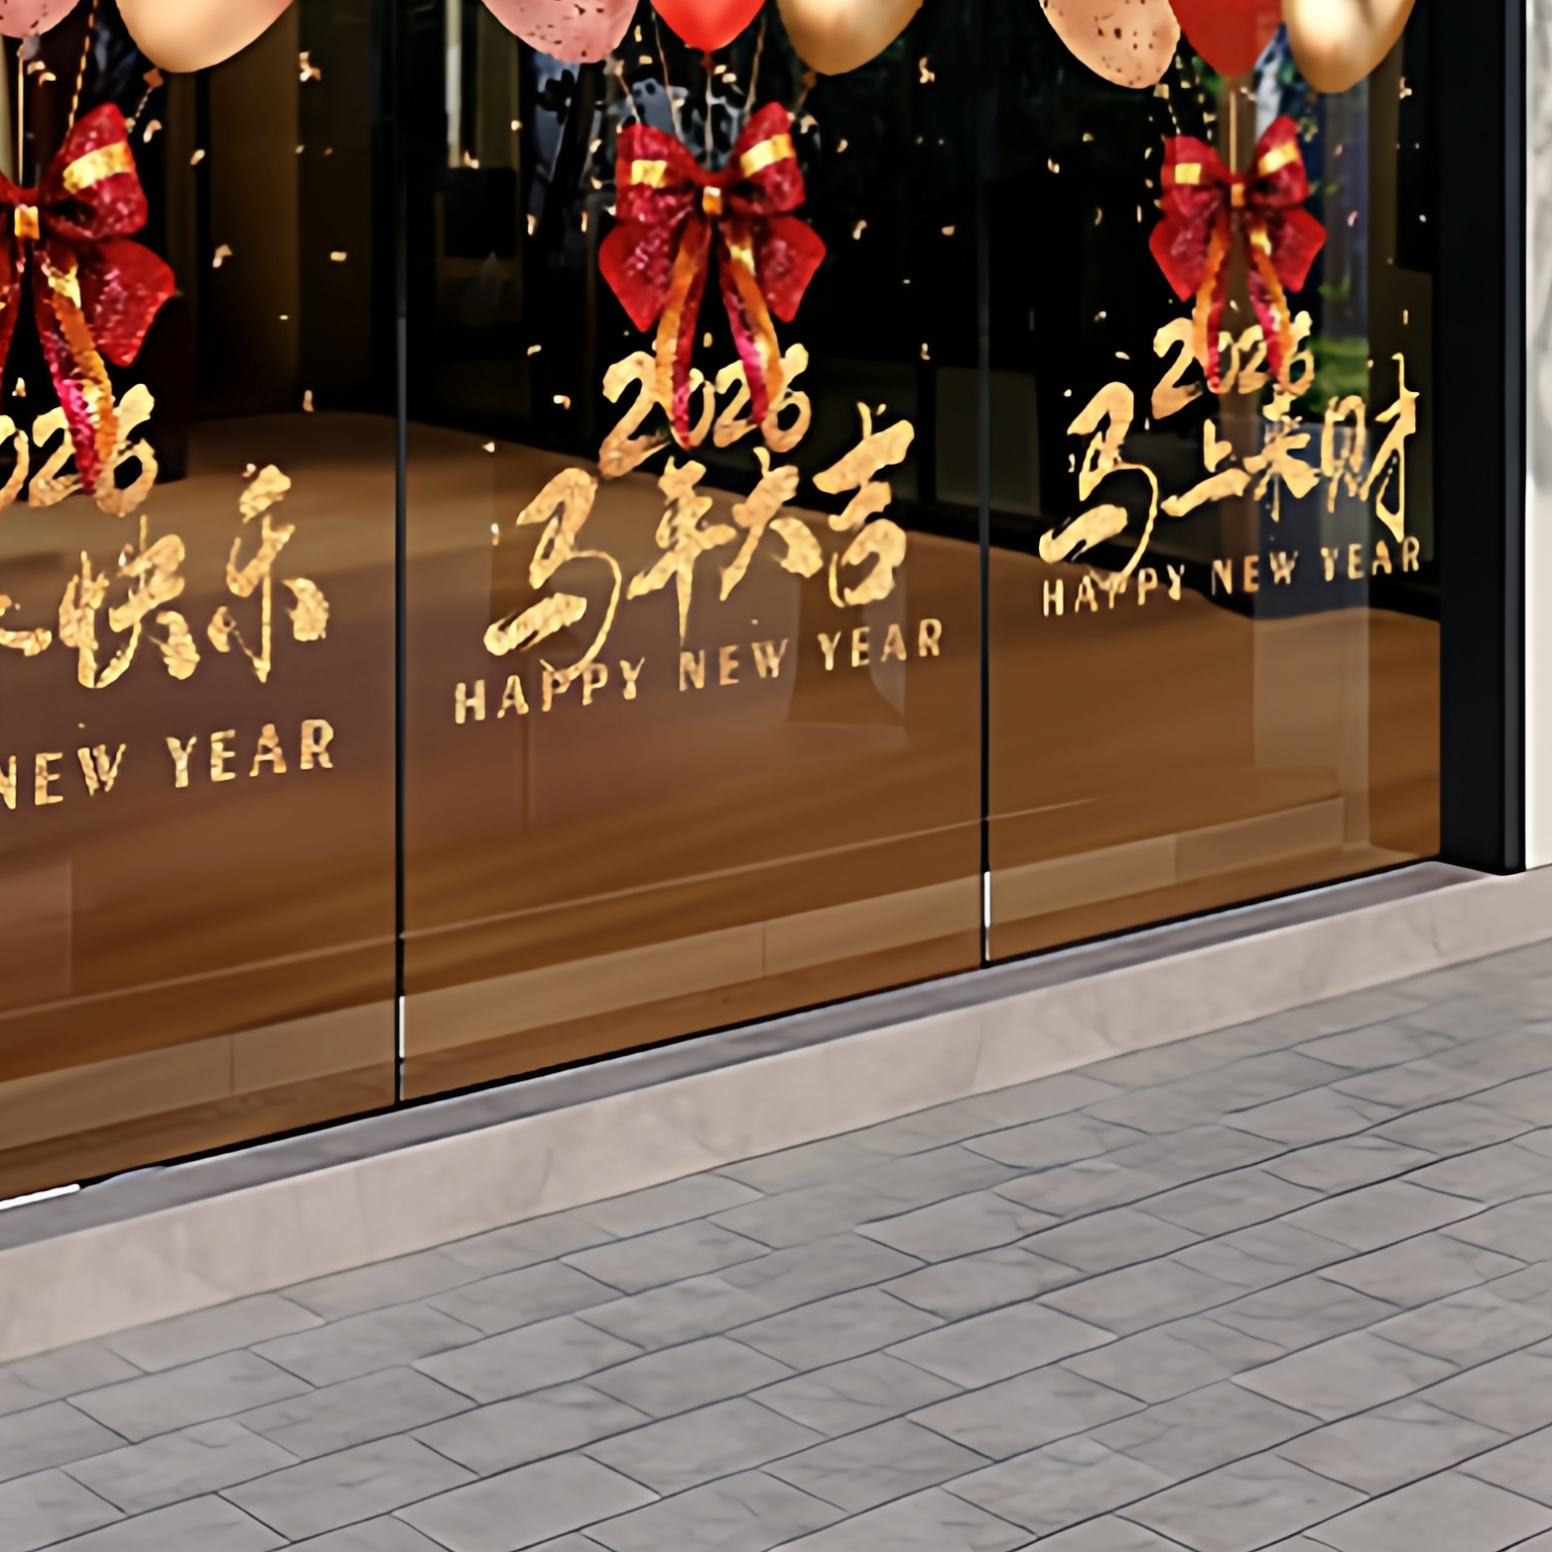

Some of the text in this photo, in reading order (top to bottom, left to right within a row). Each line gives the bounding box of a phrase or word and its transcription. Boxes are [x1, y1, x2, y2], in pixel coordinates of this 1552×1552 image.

[1211, 551, 1299, 596] NEW
[1321, 536, 1420, 582] YEAR
[454, 618, 943, 725] HAPPY NEW YEAR
[165, 718, 334, 790] YEAR
